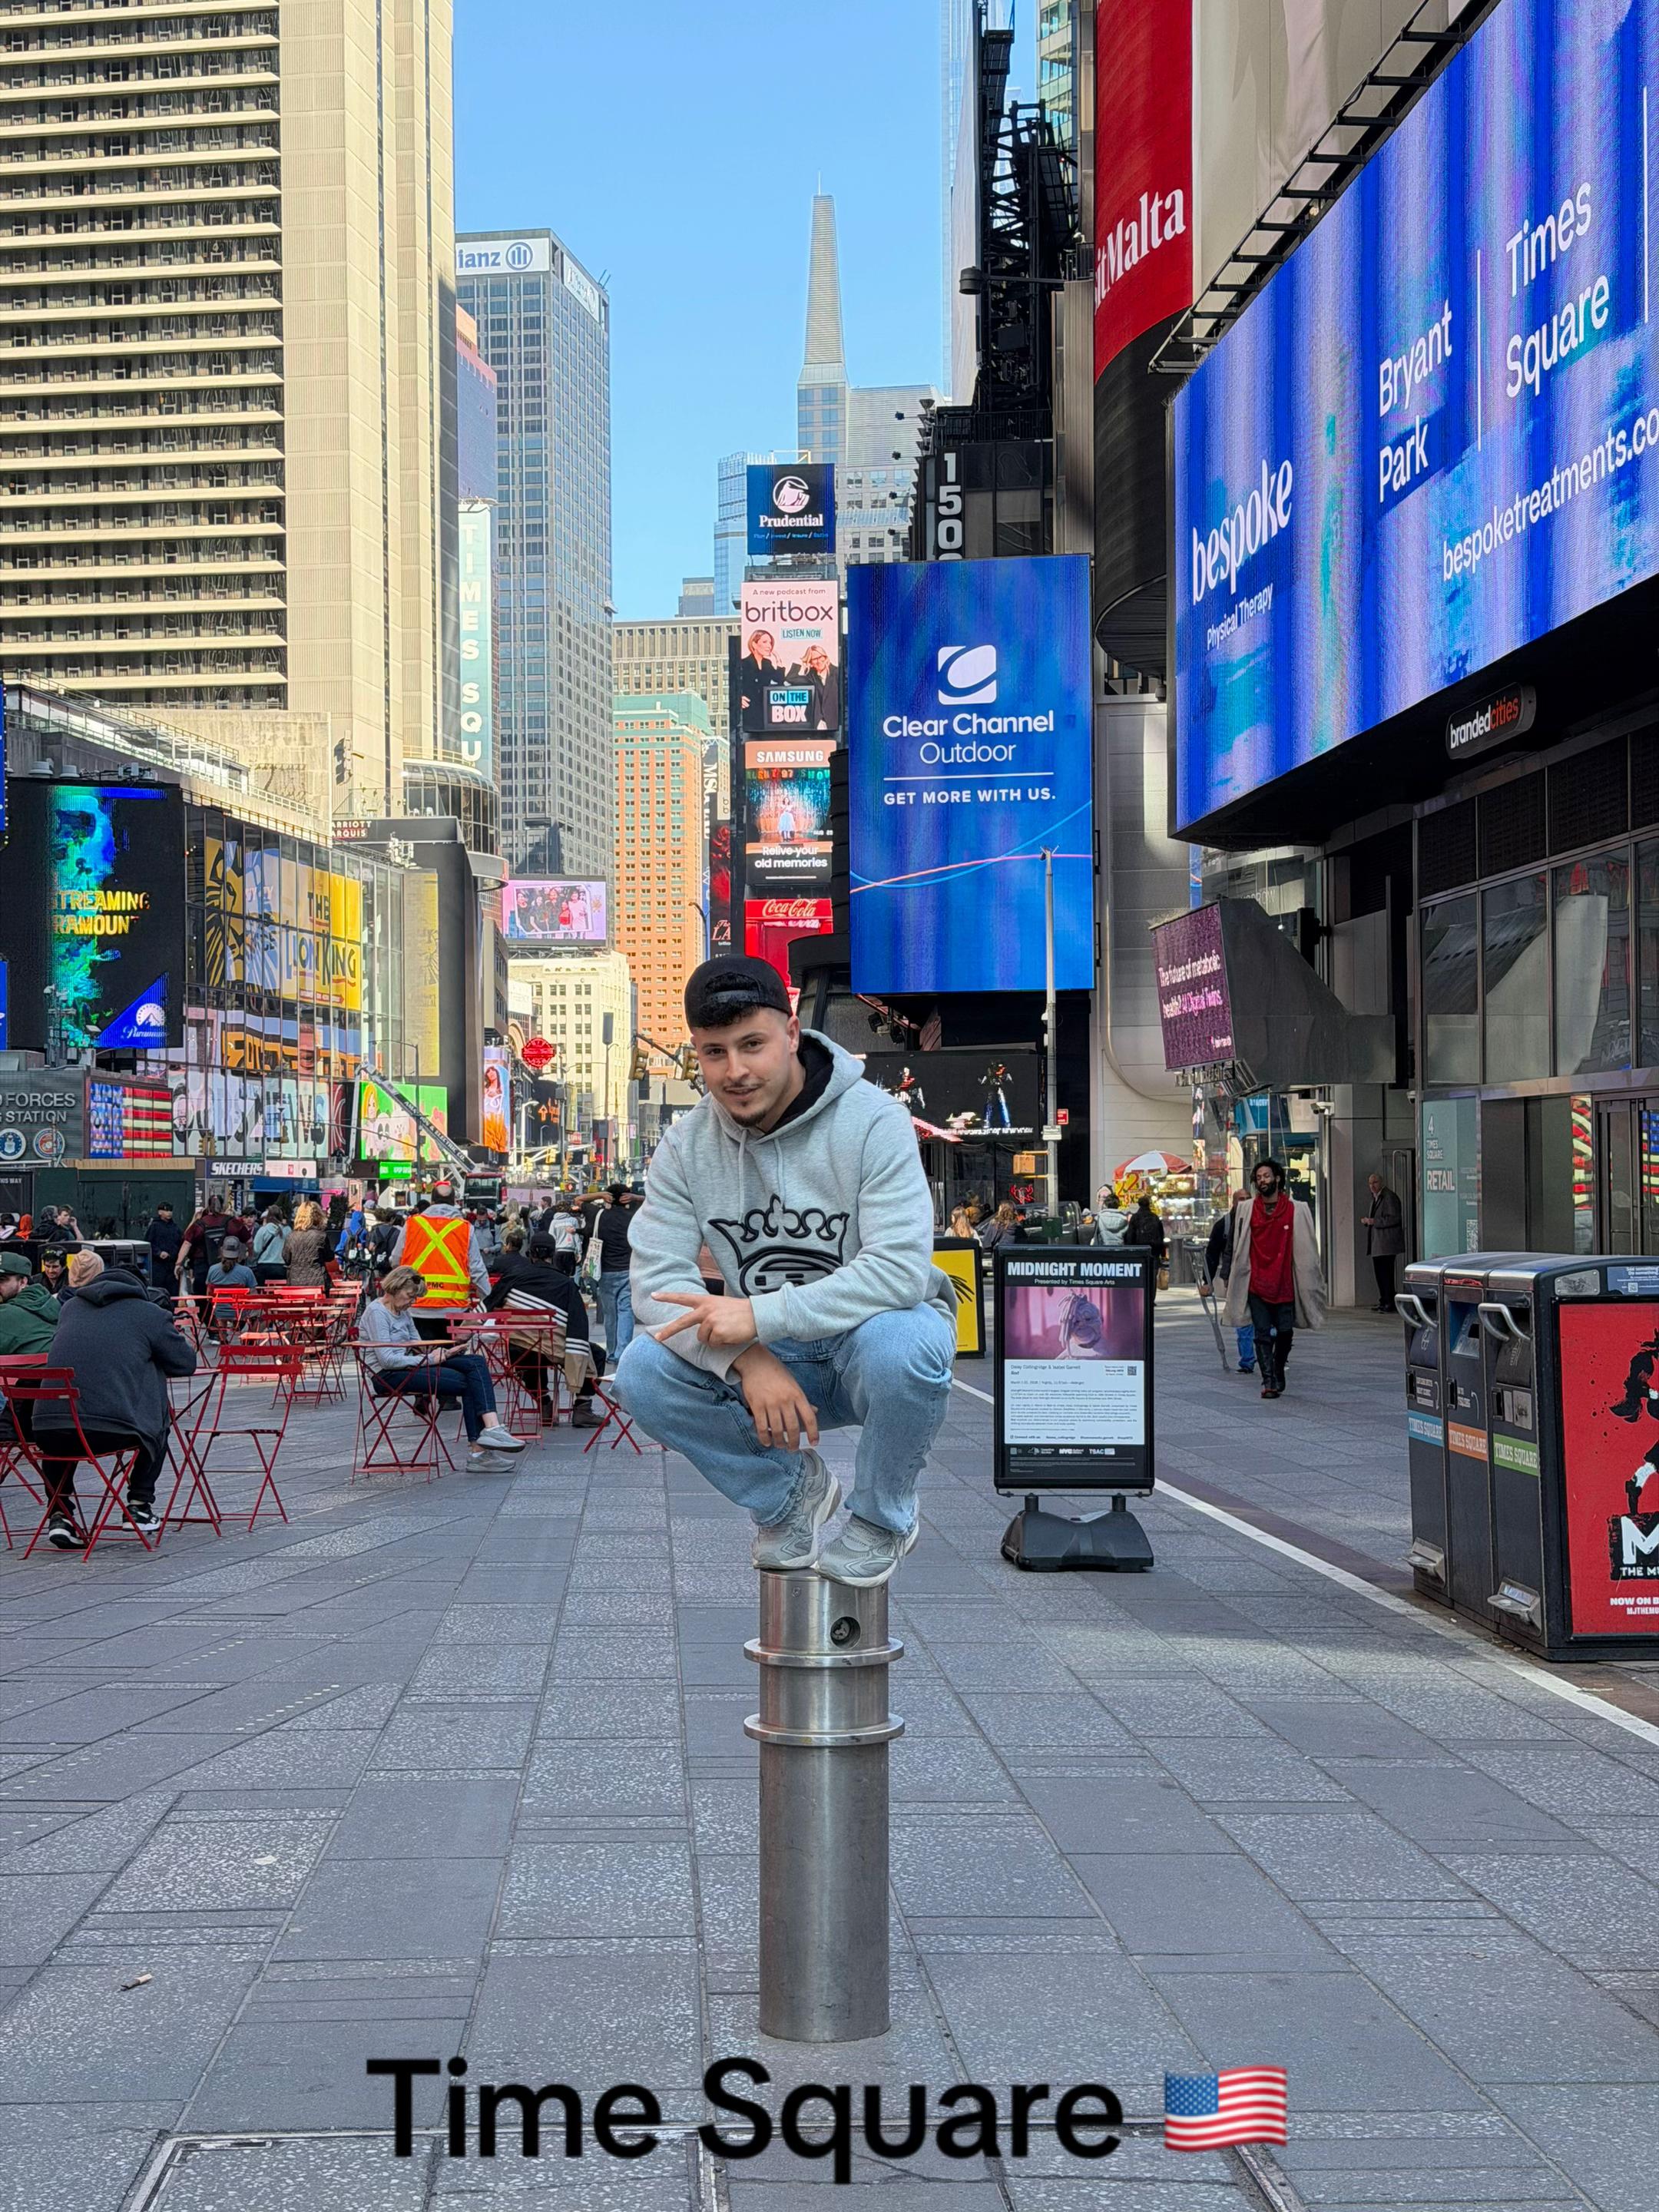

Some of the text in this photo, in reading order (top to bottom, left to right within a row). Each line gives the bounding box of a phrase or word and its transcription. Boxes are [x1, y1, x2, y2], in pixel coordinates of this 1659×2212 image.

[1505, 181, 1591, 297] Times
[1506, 273, 1610, 398] Square
[1379, 297, 1452, 418] Bryant
[1379, 415, 1429, 503] Park
[938, 452, 962, 559] 150
[1443, 408, 1659, 581] bespoketreatments.co
[759, 514, 823, 528] Prudential
[1193, 459, 1293, 605] bespoke
[460, 524, 482, 661] TIMES
[745, 601, 833, 622] britbox
[1207, 583, 1273, 651] Physical Therapy
[782, 629, 822, 638] LISTEN NOW
[772, 692, 806, 701] ON THE
[772, 706, 806, 723] BOX
[883, 710, 1054, 737] Clear Channel
[1450, 696, 1518, 749] brandedcities
[757, 751, 823, 763] SAMSUNG
[919, 741, 1016, 764] Outdoor
[883, 787, 1056, 805] GET MORE WITH US.
[755, 857, 828, 869] old memories
[762, 846, 819, 858] Relive your
[307, 892, 330, 921] THE
[322, 929, 356, 985] KING
[1158, 967, 1169, 987] The
[1169, 964, 1186, 984] future
[6, 1092, 76, 1108] FORCES
[6, 1111, 67, 1123] STATION
[1428, 1115, 1434, 1135] 4
[211, 1161, 263, 1176] SKECHERS
[1427, 1170, 1455, 1191] RETAIL
[1008, 1262, 1142, 1277] MIDNIGHT MOMENT
[1409, 1416, 1443, 1441] TIMES SQUARE
[1450, 1429, 1487, 1453] TIMES SQUARE
[1495, 1442, 1538, 1468] TIMES SQUARE
[1620, 1567, 1643, 1576] THE
[1610, 1598, 1635, 1606] NOW
[1636, 1597, 1651, 1605] ON
